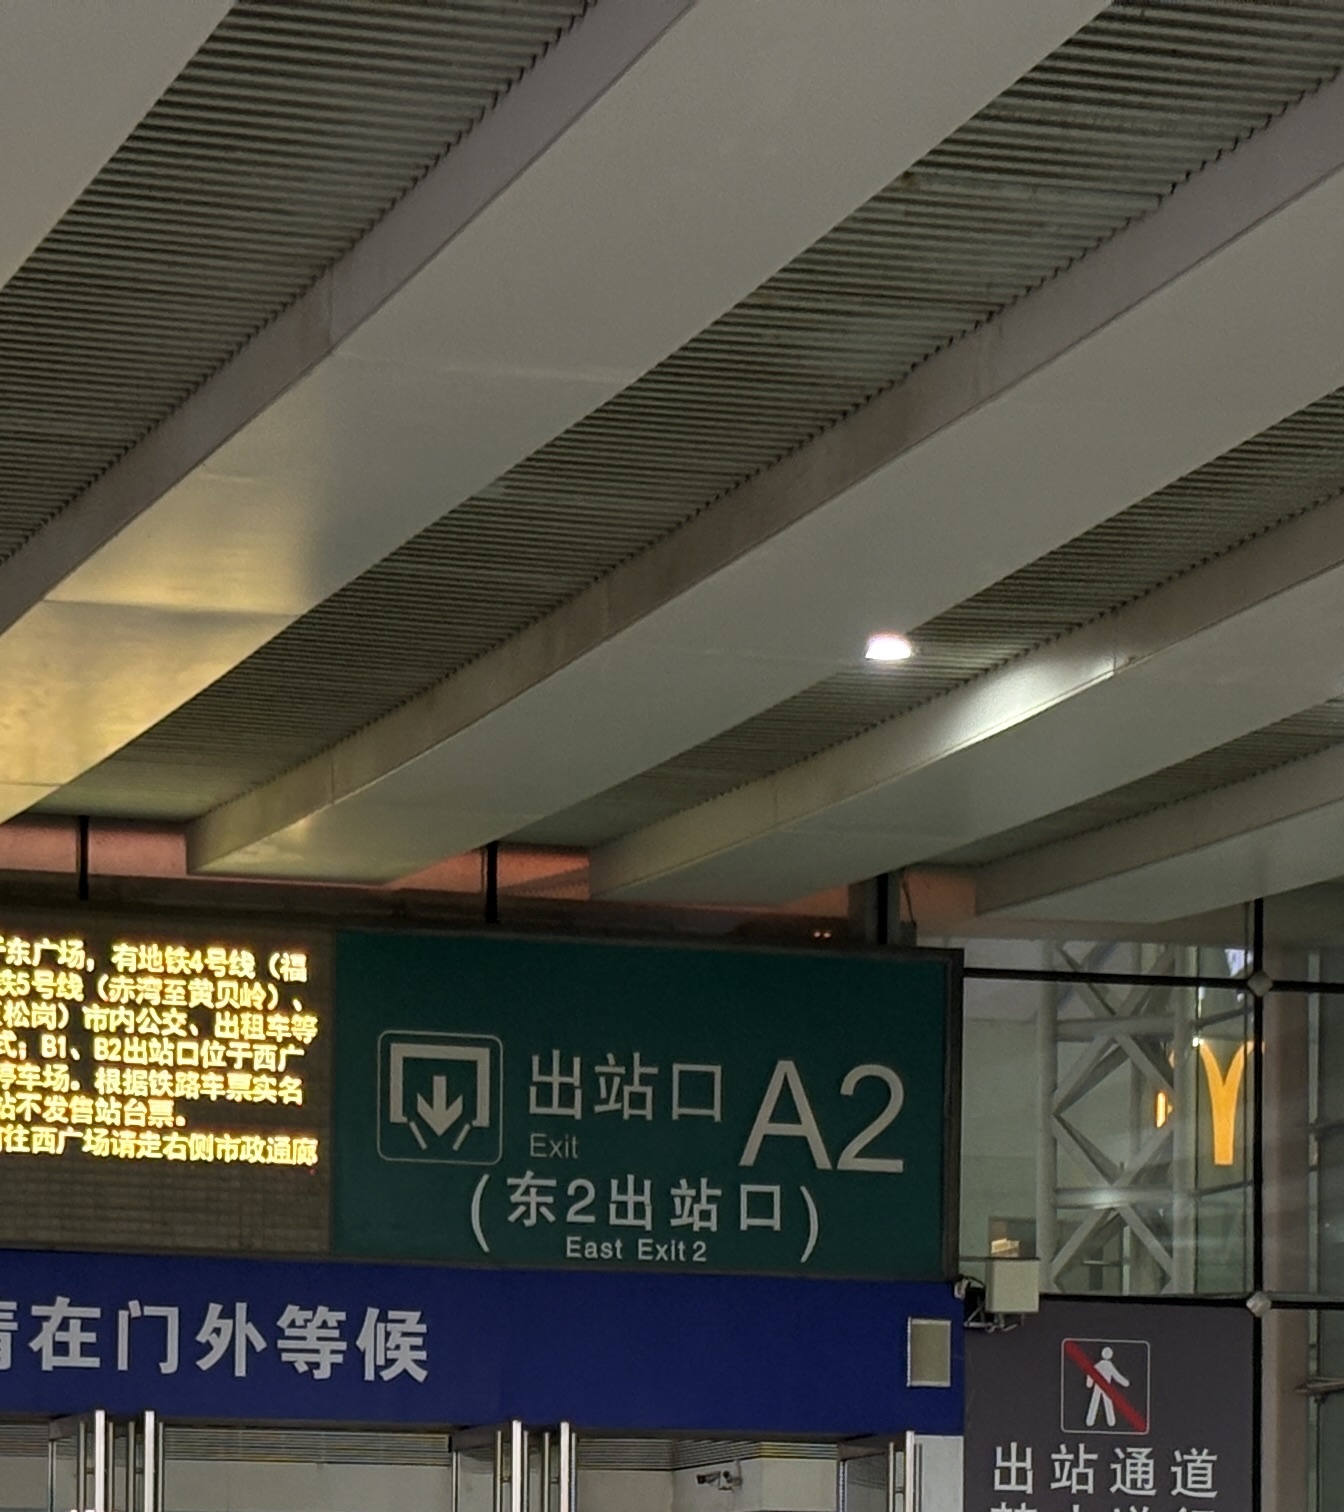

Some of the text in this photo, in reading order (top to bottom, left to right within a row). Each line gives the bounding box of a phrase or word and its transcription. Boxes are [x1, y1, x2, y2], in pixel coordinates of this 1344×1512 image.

[528, 1048, 905, 1173] 出站口 A2
[529, 1133, 579, 1159] Exit
[566, 1237, 707, 1263] East Exit 2
[993, 1442, 1218, 1498] 出站通道
